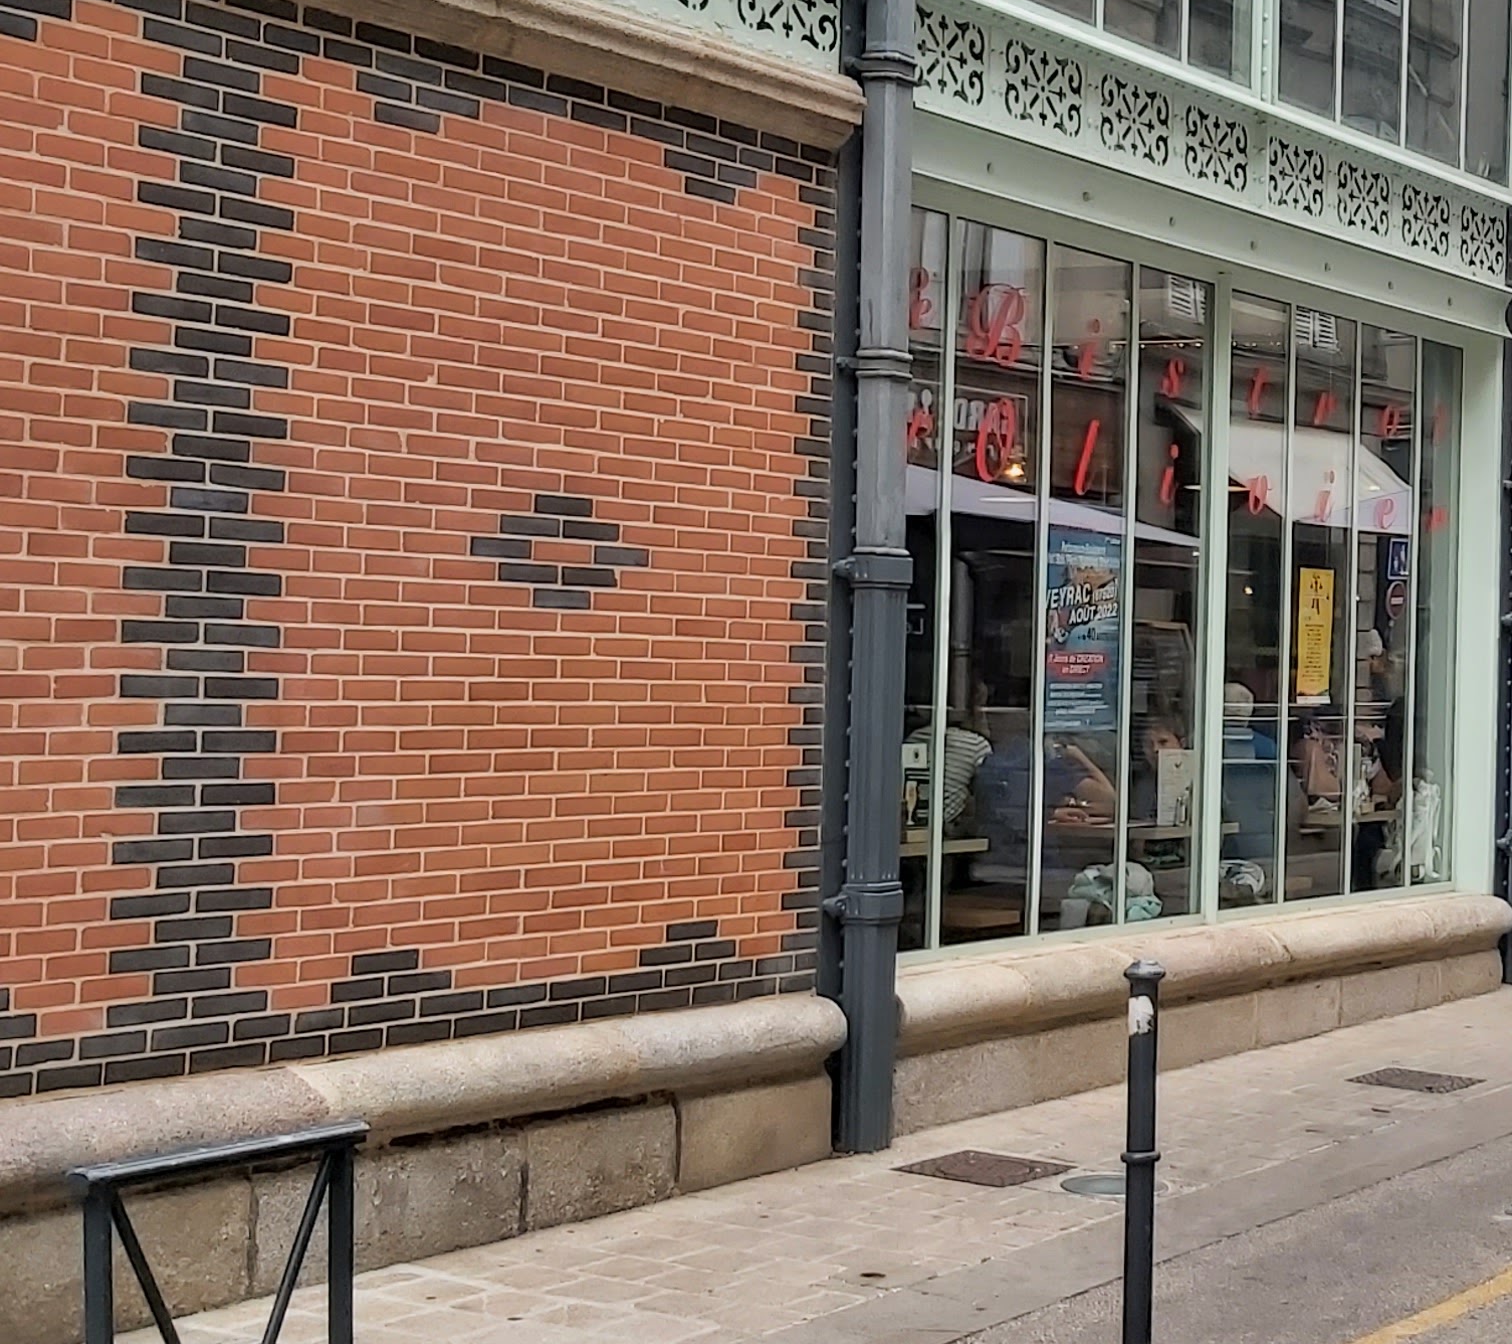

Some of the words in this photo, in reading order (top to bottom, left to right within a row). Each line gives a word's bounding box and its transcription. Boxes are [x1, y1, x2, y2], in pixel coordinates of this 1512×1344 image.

[976, 397, 1448, 532] Olivier
[1069, 604, 1096, 625] AOÛT
[1094, 602, 1118, 621] 2022
